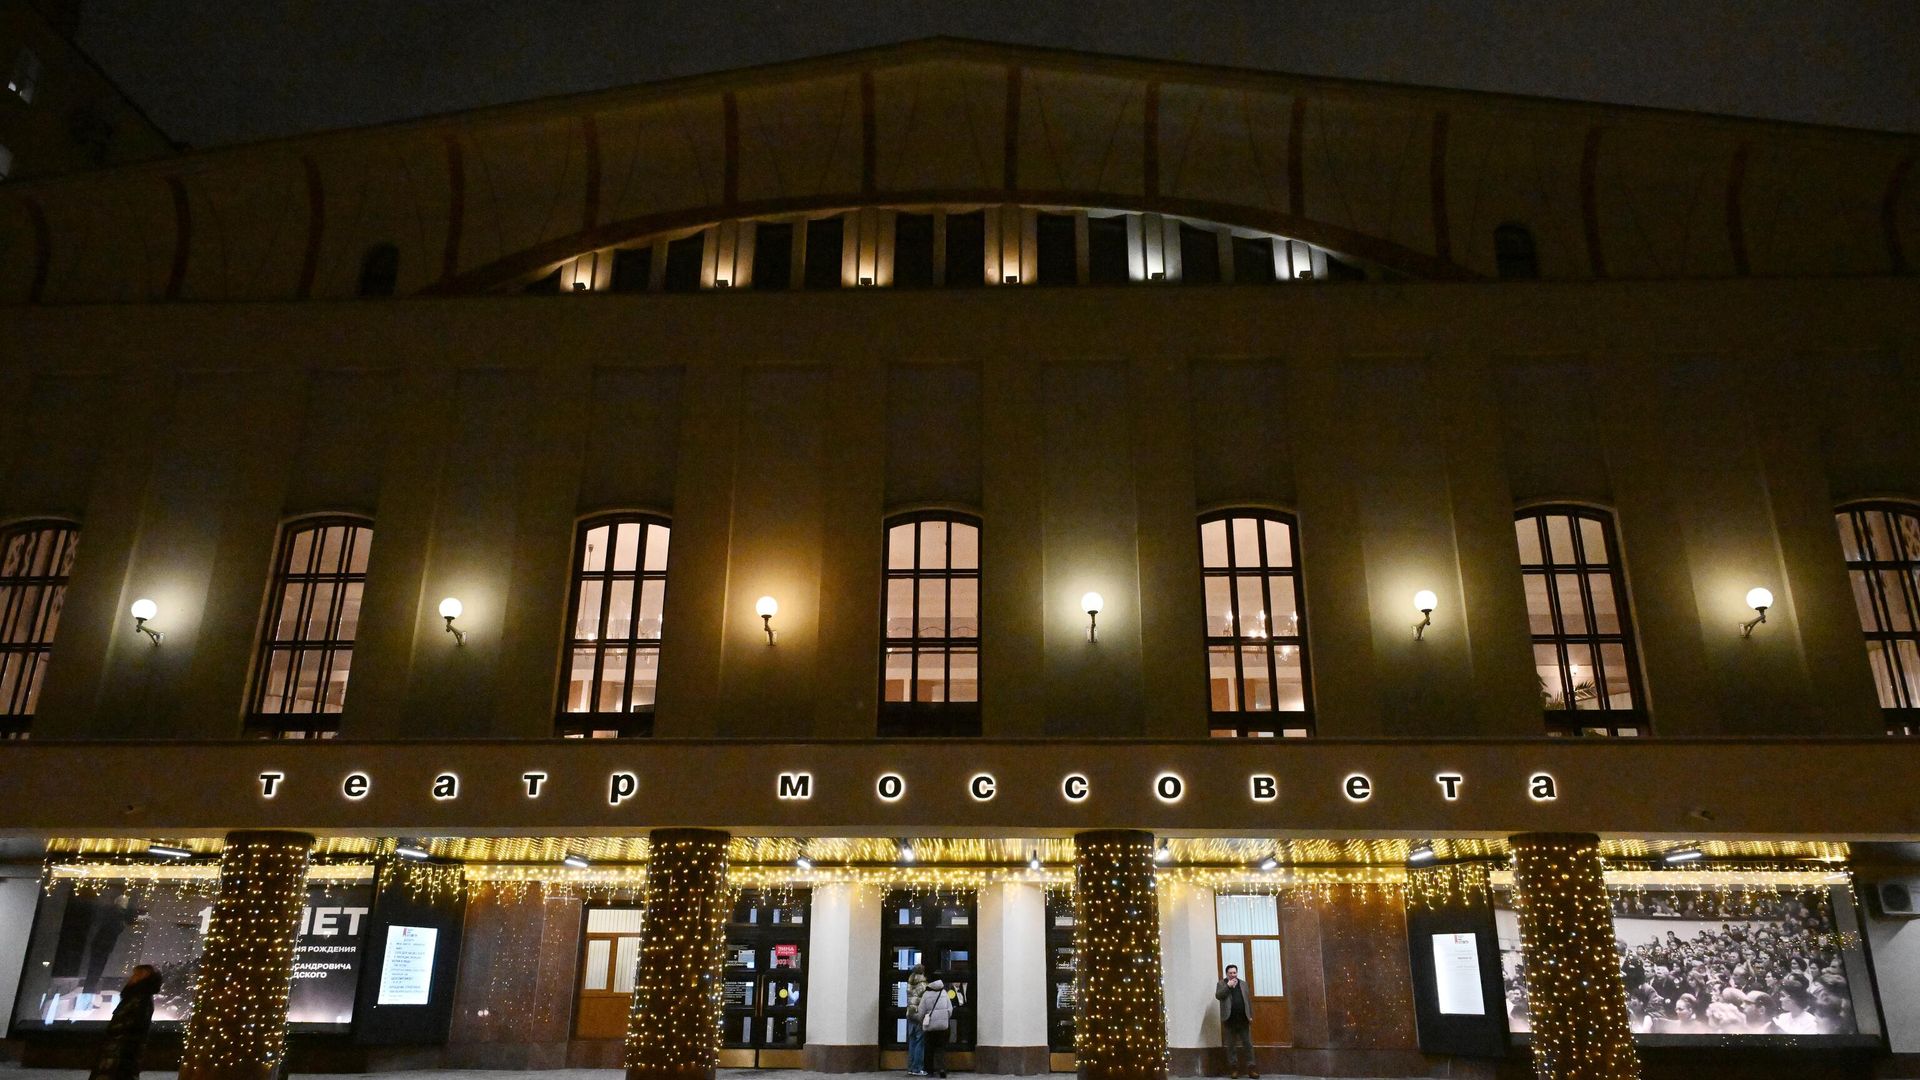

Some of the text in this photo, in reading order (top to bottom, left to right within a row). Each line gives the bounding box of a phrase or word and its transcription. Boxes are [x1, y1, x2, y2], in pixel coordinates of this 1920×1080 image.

[260, 771, 1556, 804] театр моссовета
[294, 963, 352, 971] САНДРОВИЧА
[293, 971, 328, 979] ДСКОГО
